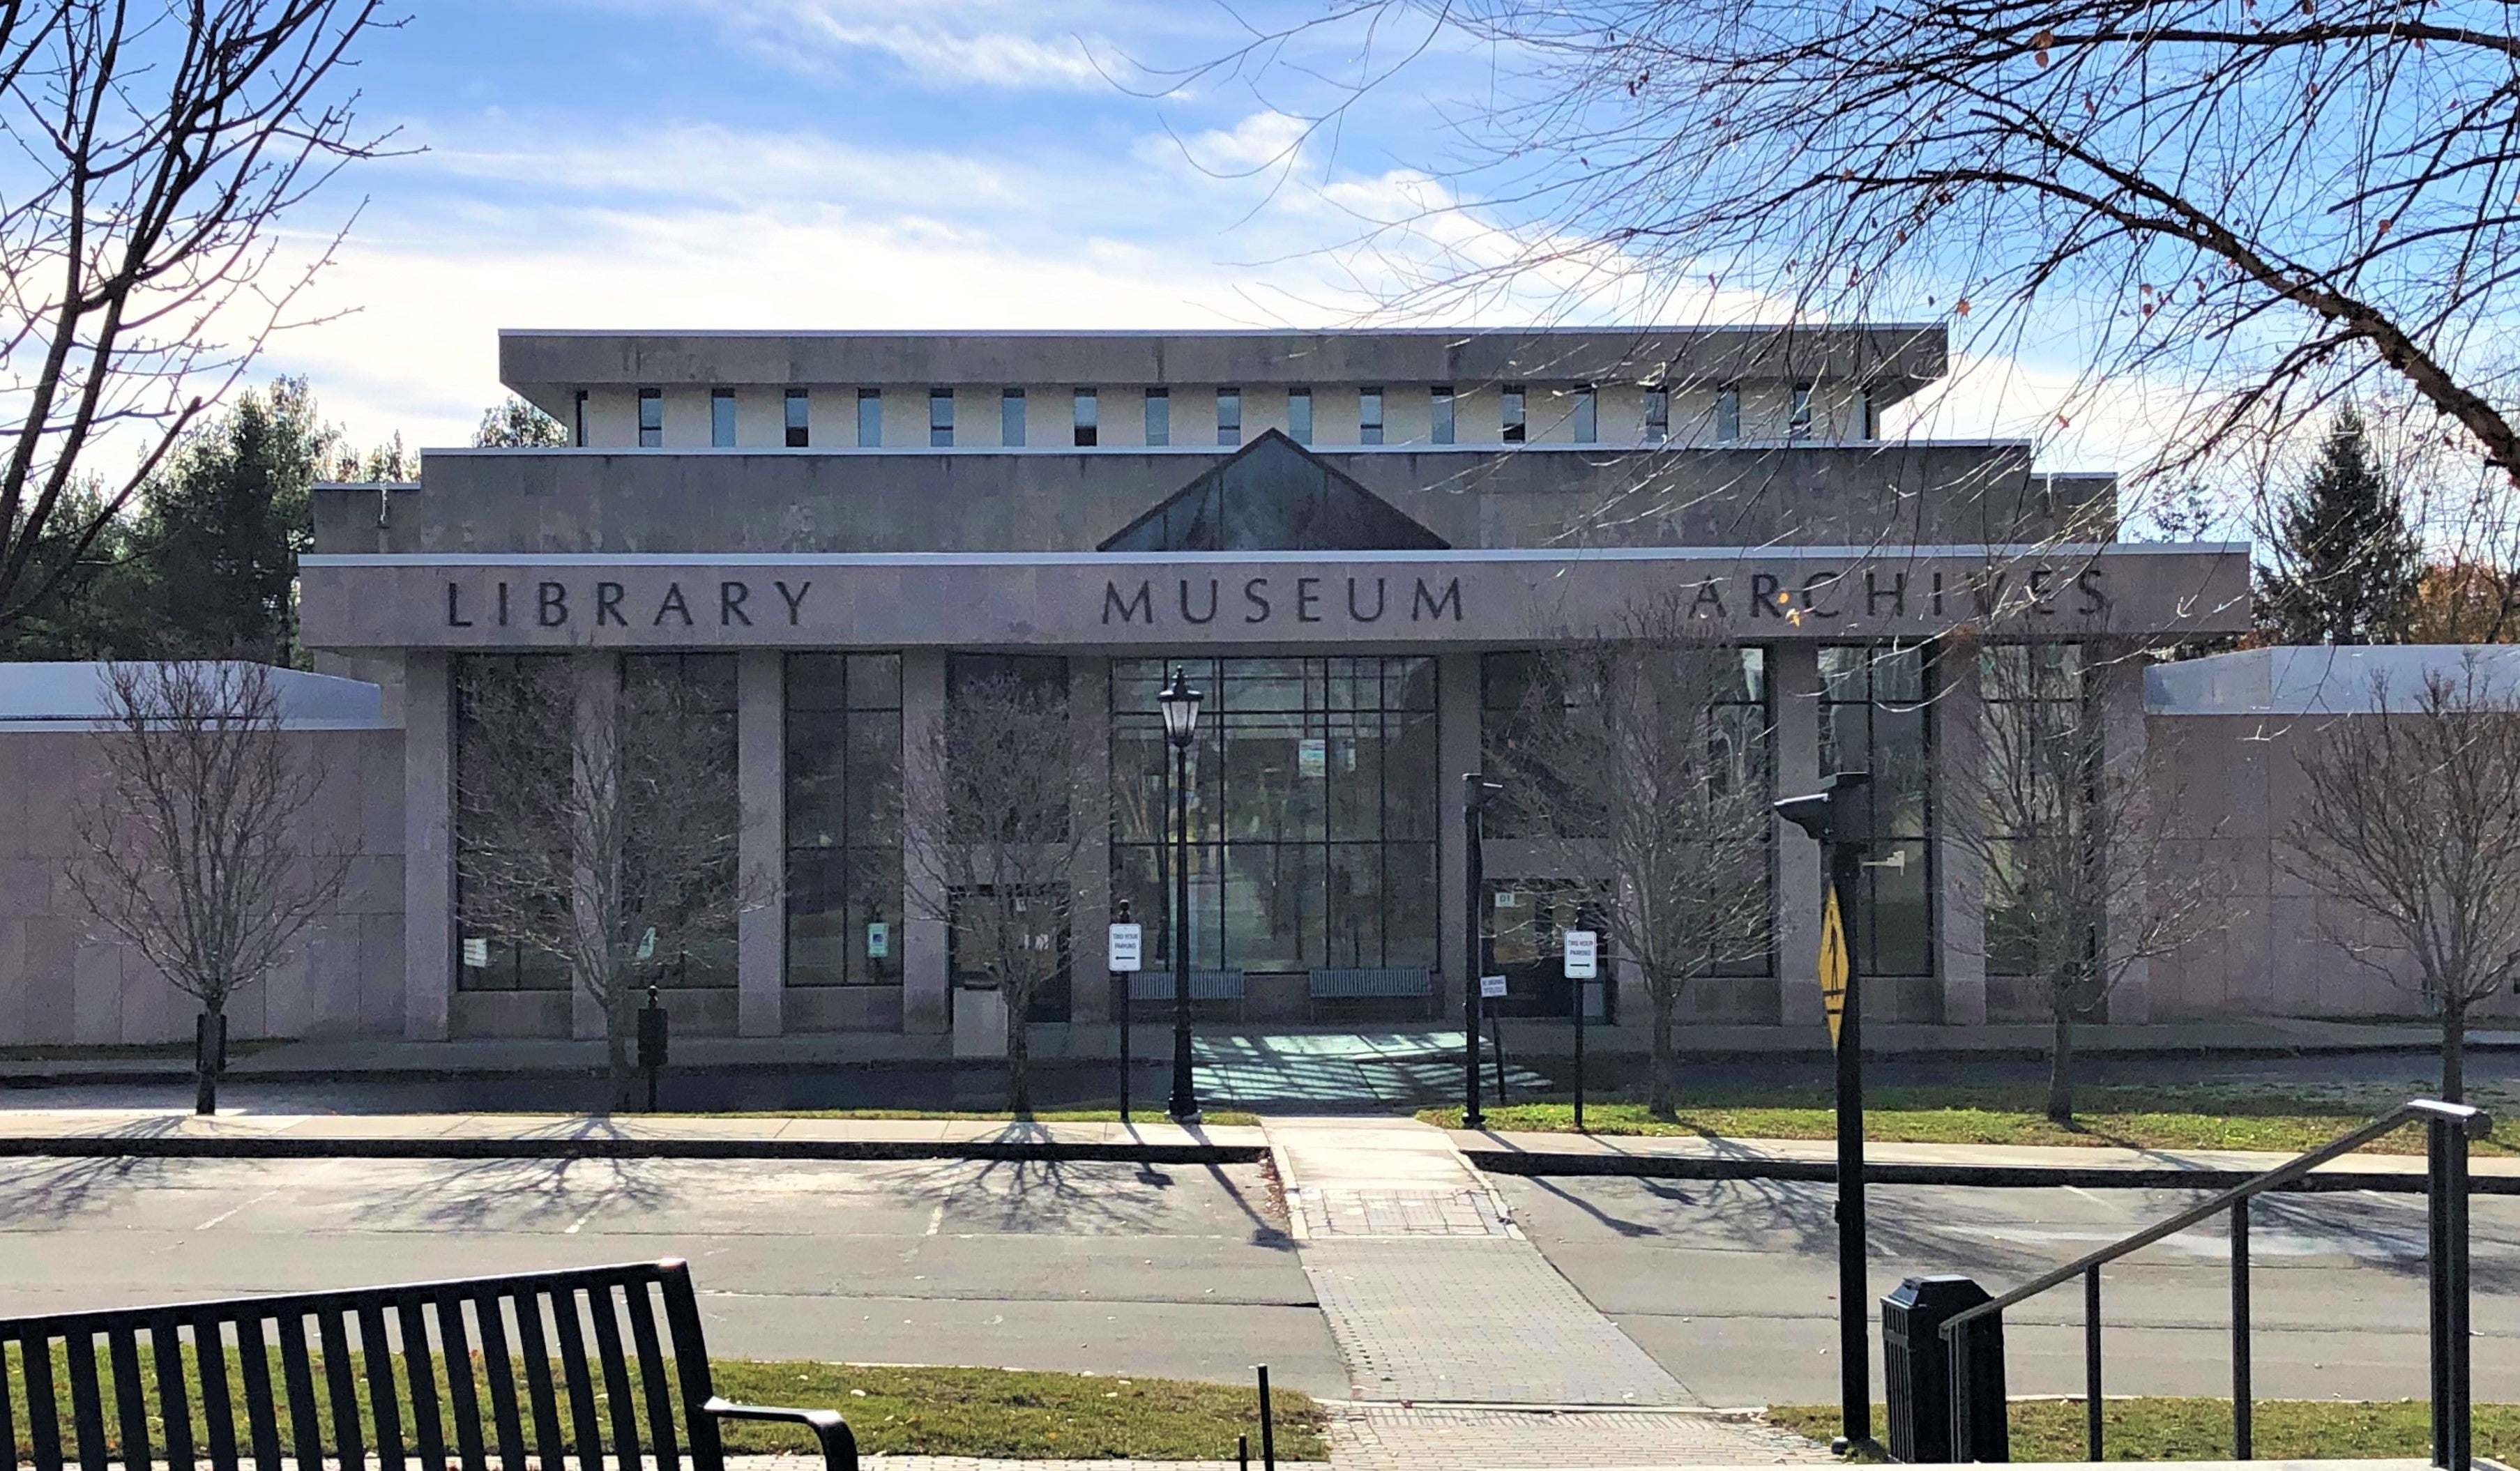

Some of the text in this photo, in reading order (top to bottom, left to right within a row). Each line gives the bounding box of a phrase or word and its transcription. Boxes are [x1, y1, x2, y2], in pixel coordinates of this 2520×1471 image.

[448, 570, 2108, 627] LIBRARY MUSEUM ARCHIVES
